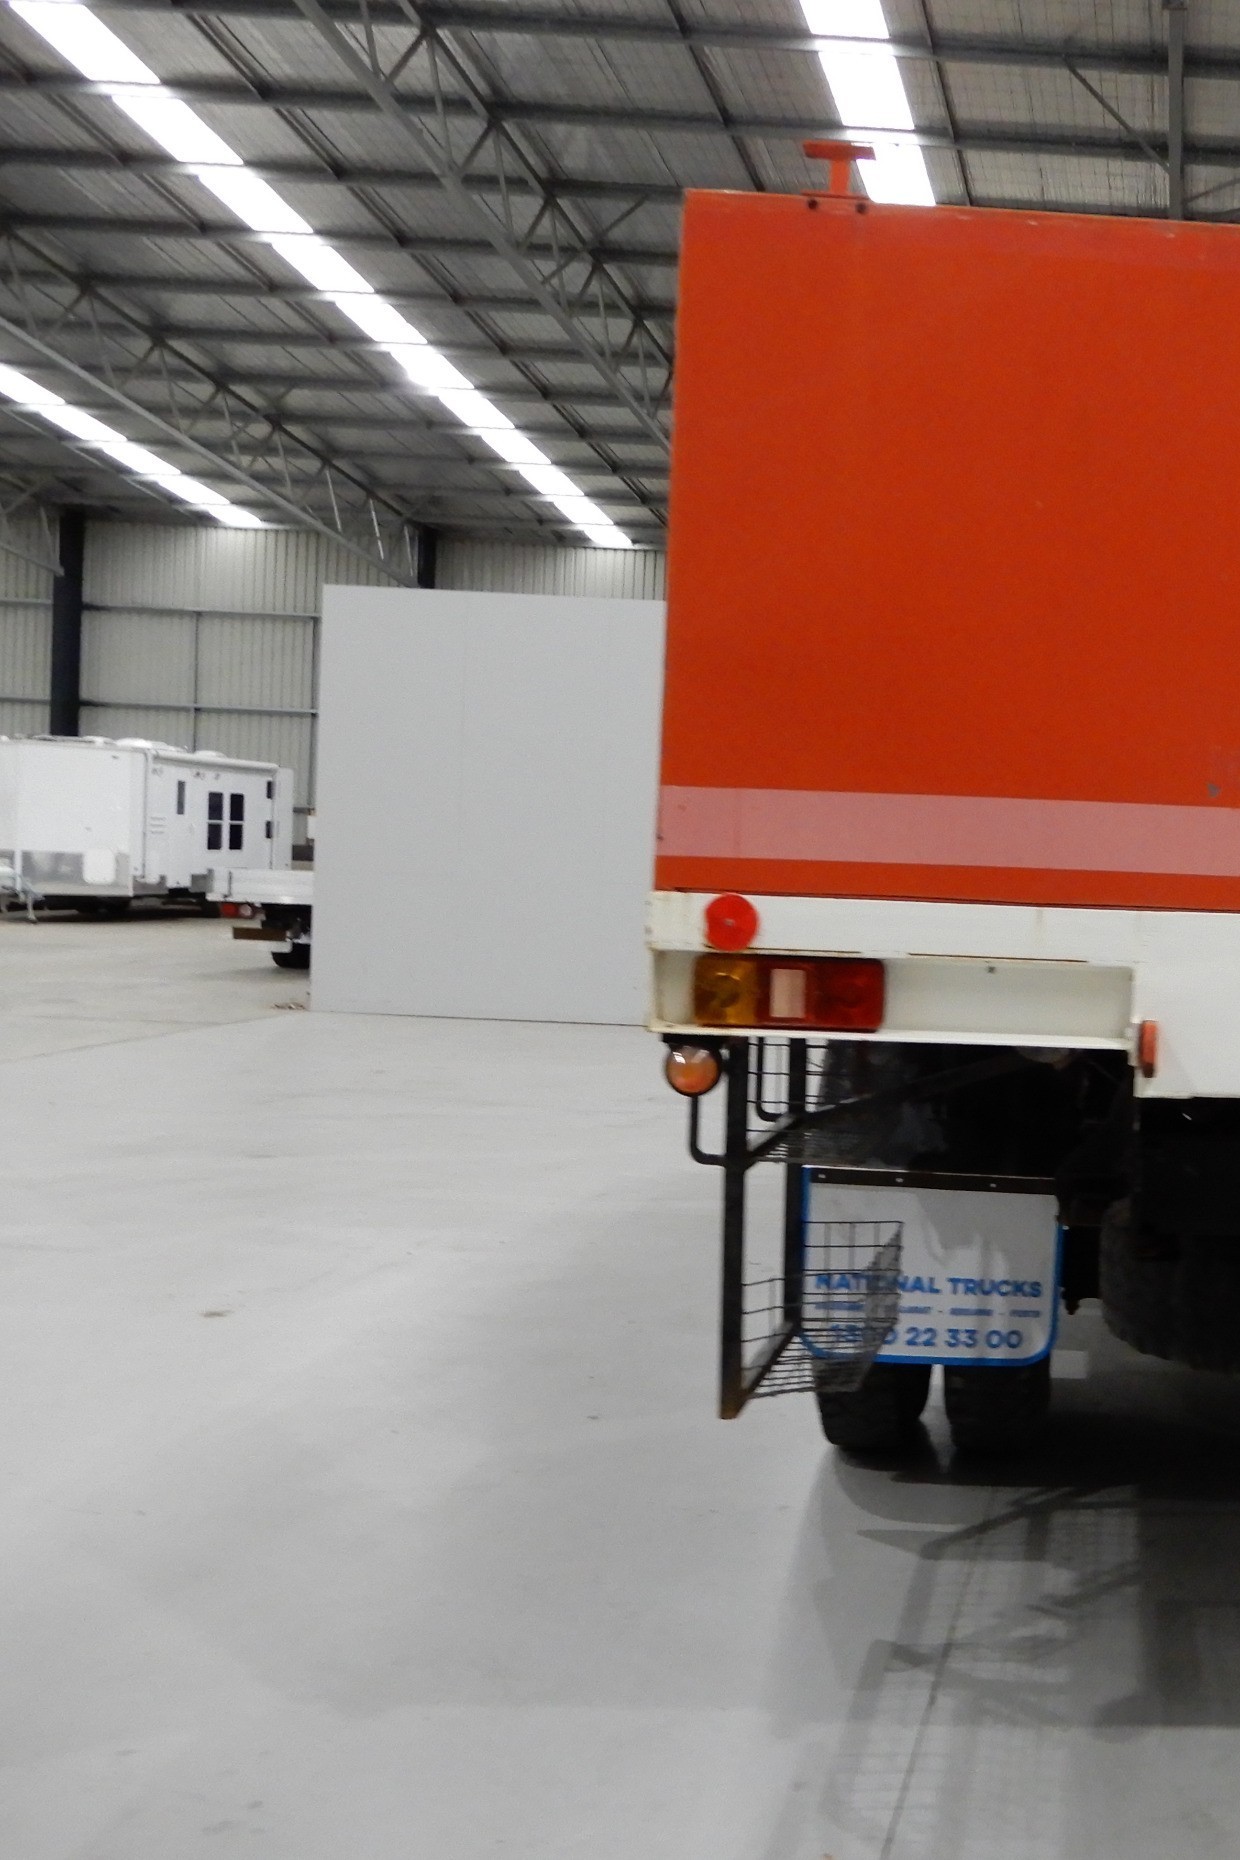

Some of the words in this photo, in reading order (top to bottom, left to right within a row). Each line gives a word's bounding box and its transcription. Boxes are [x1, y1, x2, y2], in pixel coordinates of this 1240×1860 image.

[947, 1277, 1042, 1297] TRUCKS
[905, 1326, 937, 1347] 22
[943, 1328, 979, 1348] 33
[985, 1329, 1022, 1349] 00
